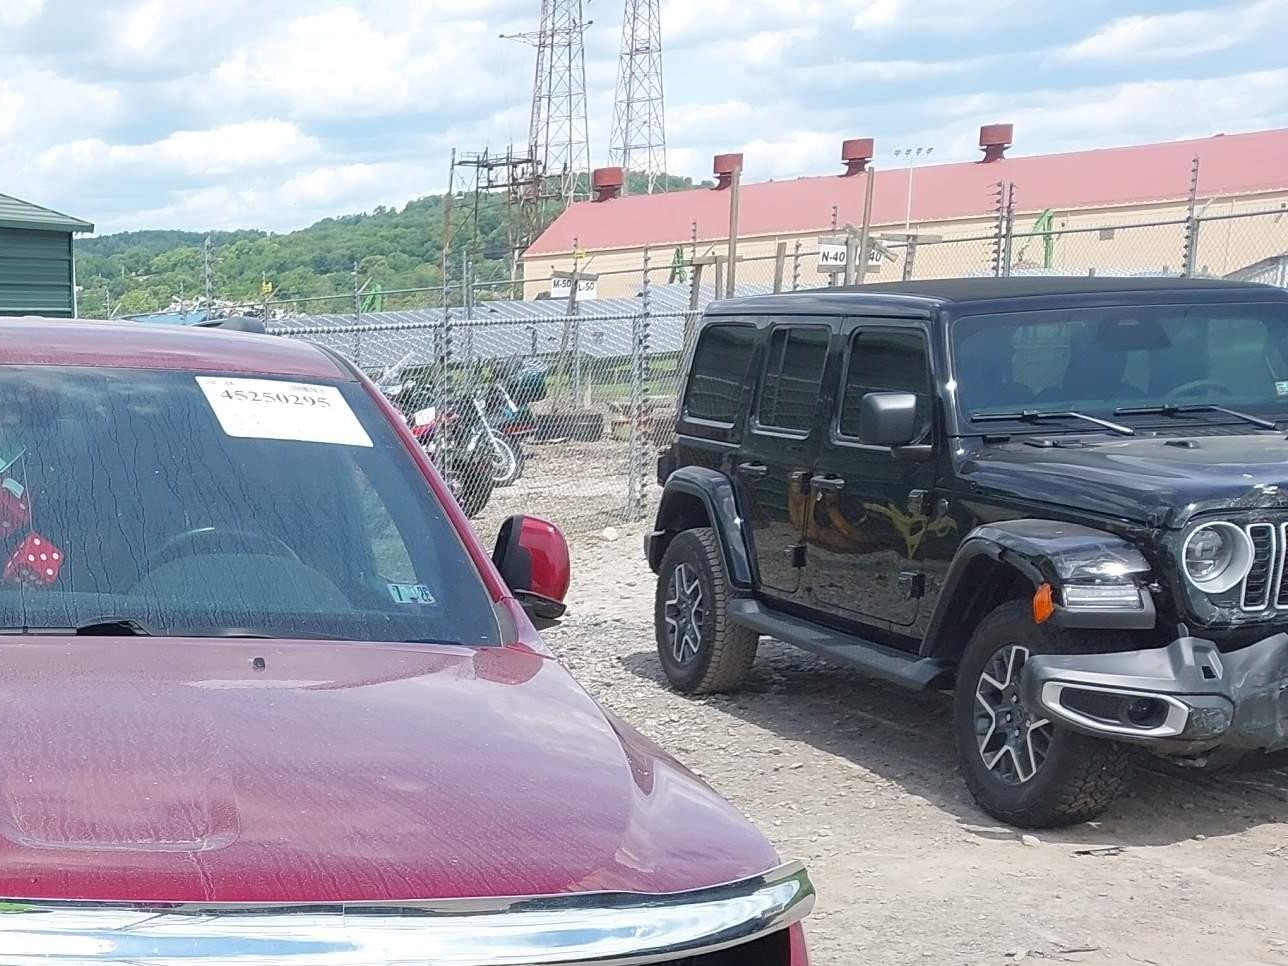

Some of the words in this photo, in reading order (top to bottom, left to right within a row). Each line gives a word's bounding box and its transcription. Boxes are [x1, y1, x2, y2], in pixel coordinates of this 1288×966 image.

[821, 251, 846, 262] N-40
[552, 279, 572, 288] M-50
[578, 281, 595, 291] L-50
[220, 388, 331, 408] 45250295
